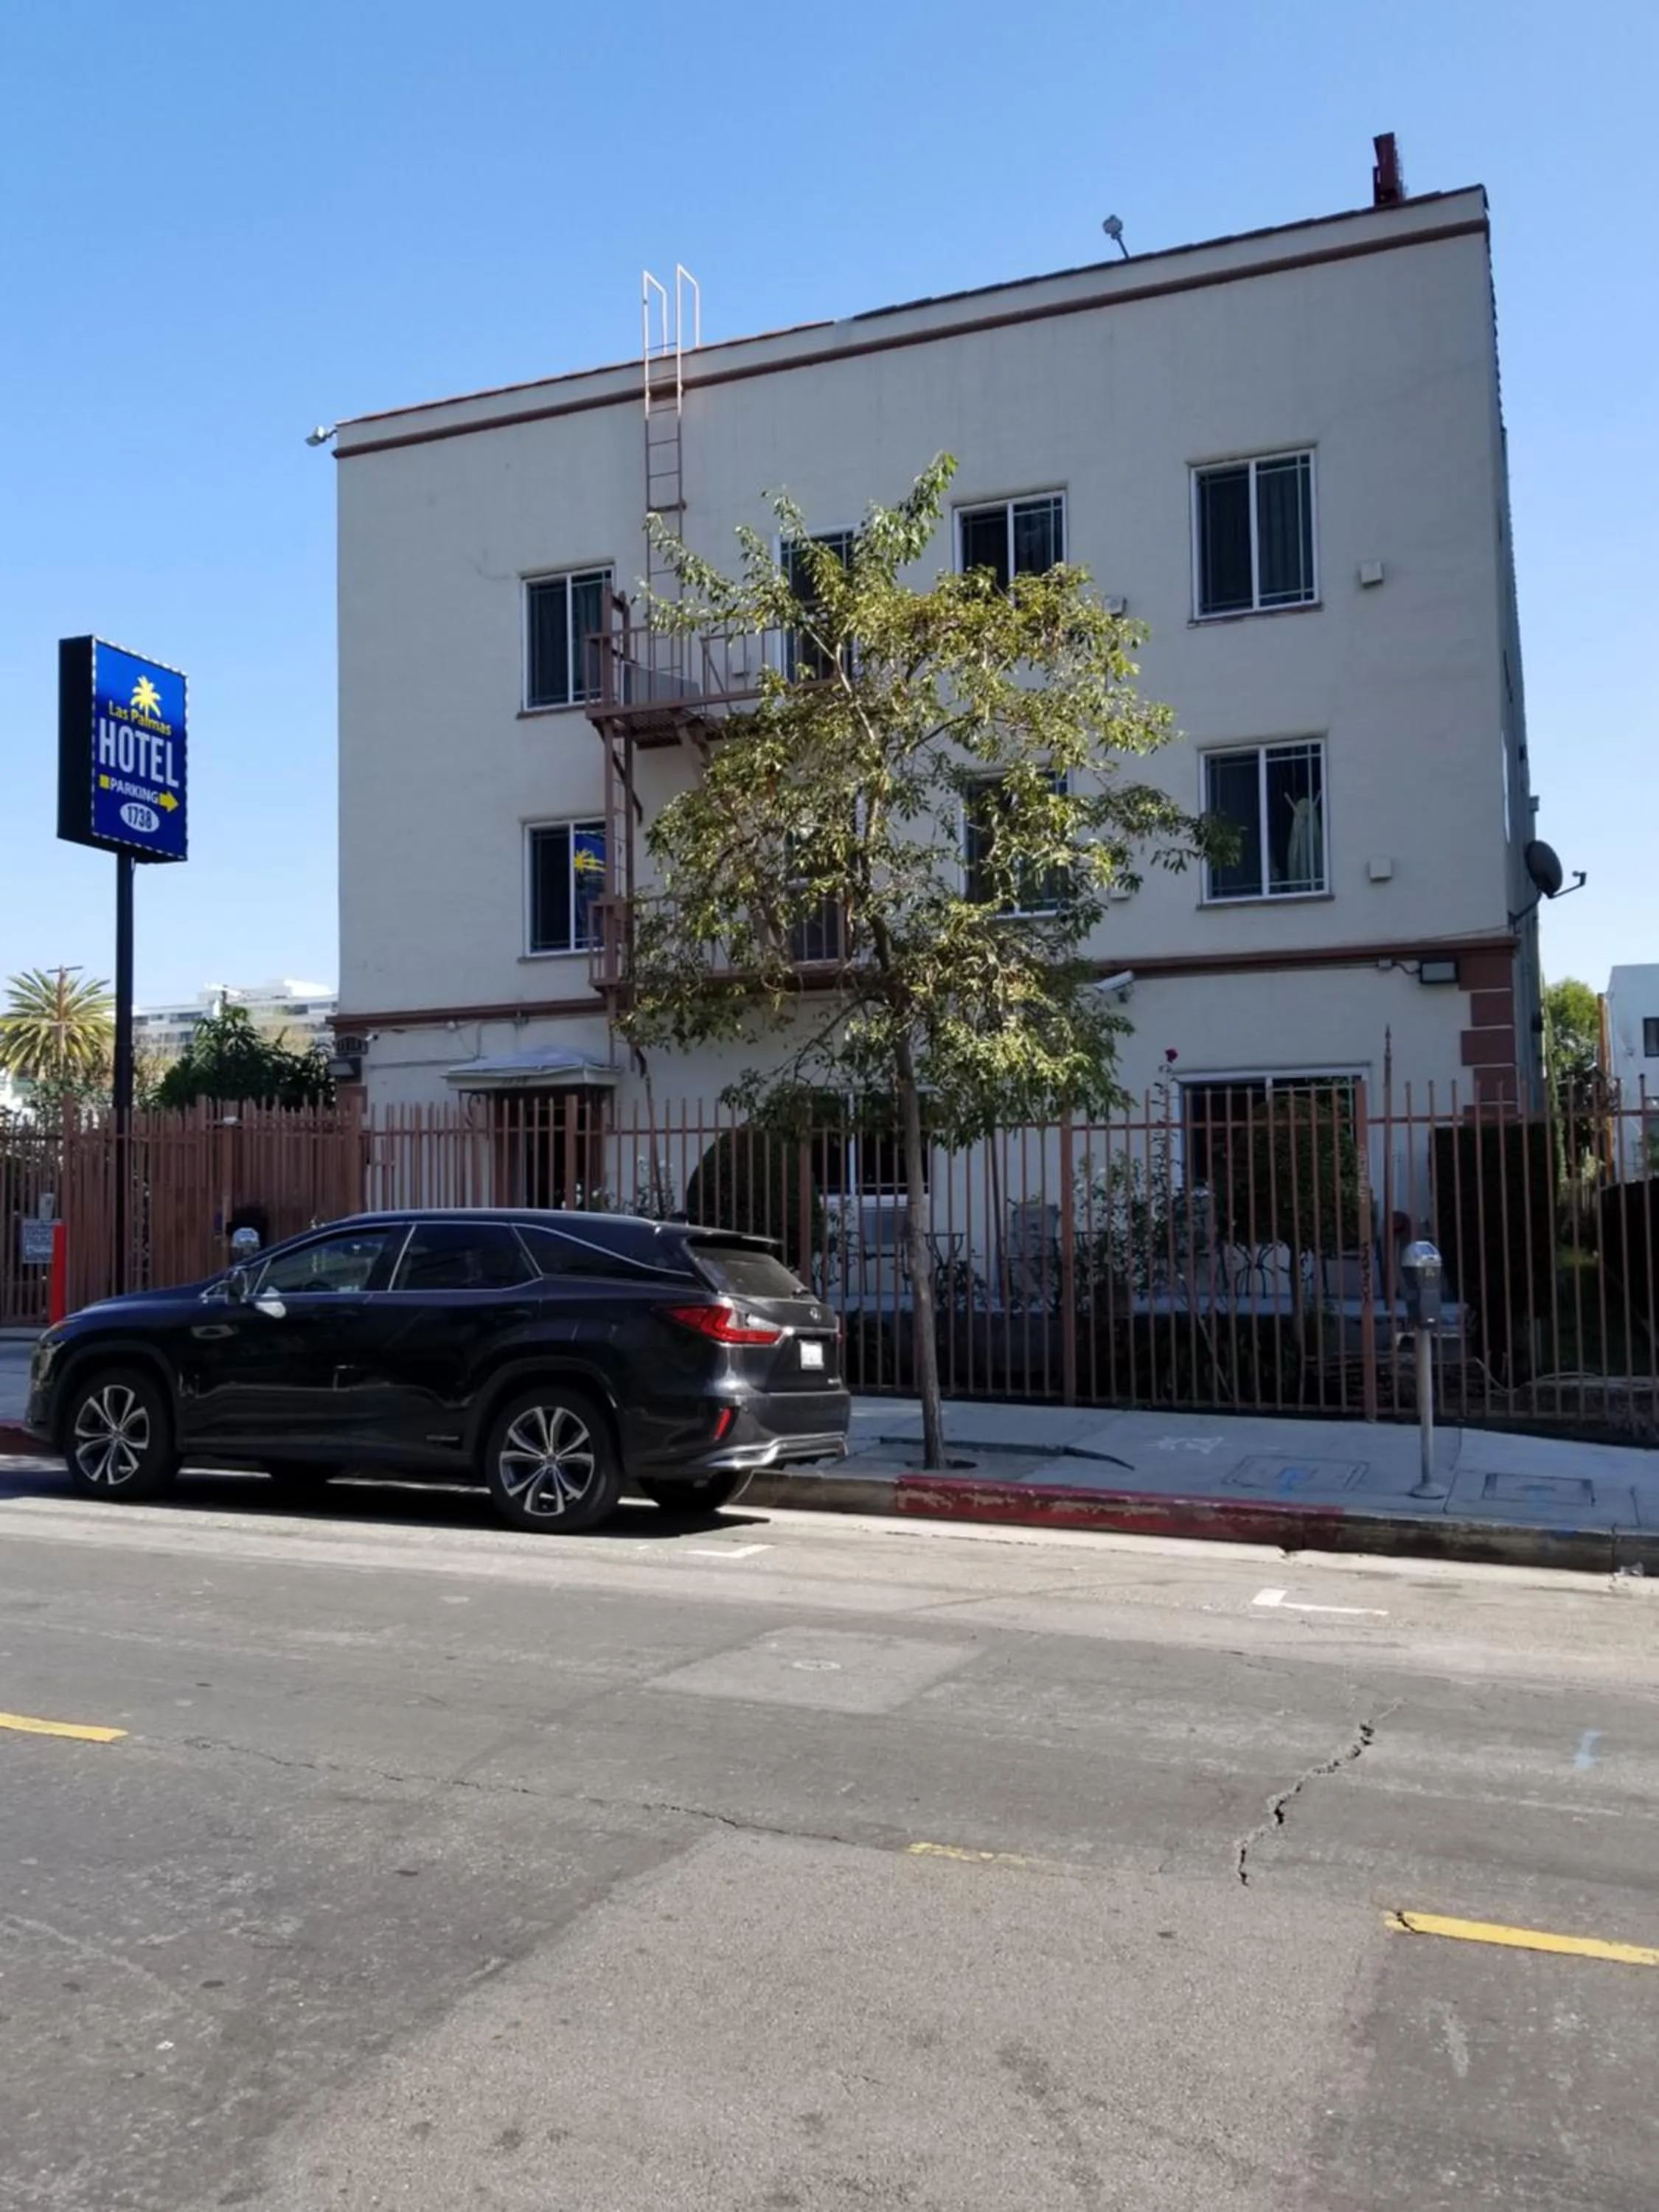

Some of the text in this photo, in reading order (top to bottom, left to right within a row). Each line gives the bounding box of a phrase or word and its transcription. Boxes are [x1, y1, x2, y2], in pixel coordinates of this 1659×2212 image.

[108, 700, 172, 736] Las Palmas
[99, 717, 179, 789] HOTEL
[110, 776, 159, 804] PARKING
